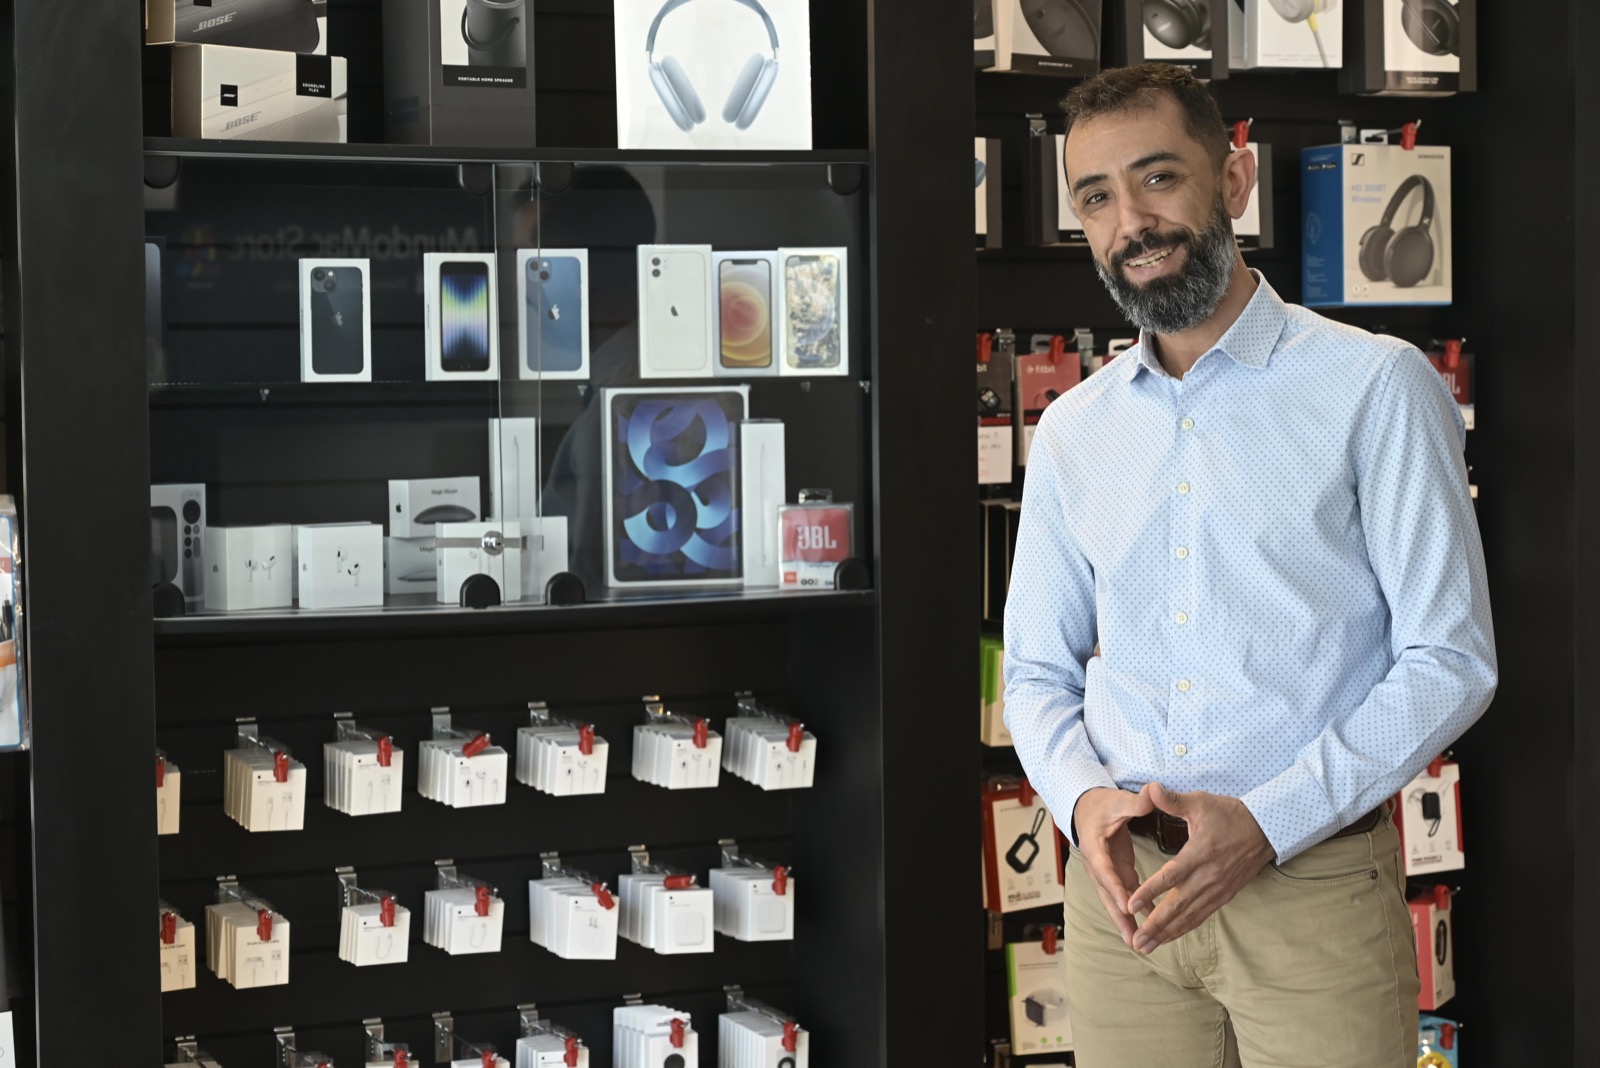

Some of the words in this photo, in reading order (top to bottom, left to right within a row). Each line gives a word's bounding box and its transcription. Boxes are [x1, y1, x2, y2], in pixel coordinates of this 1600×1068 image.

[193, 12, 237, 33] BOSE
[220, 111, 262, 132] BOSE
[1351, 194, 1382, 204] Wireless
[1035, 364, 1056, 374] fitbit
[1443, 373, 1461, 394] BL
[431, 488, 443, 496] Magic
[796, 525, 838, 550] JBL
